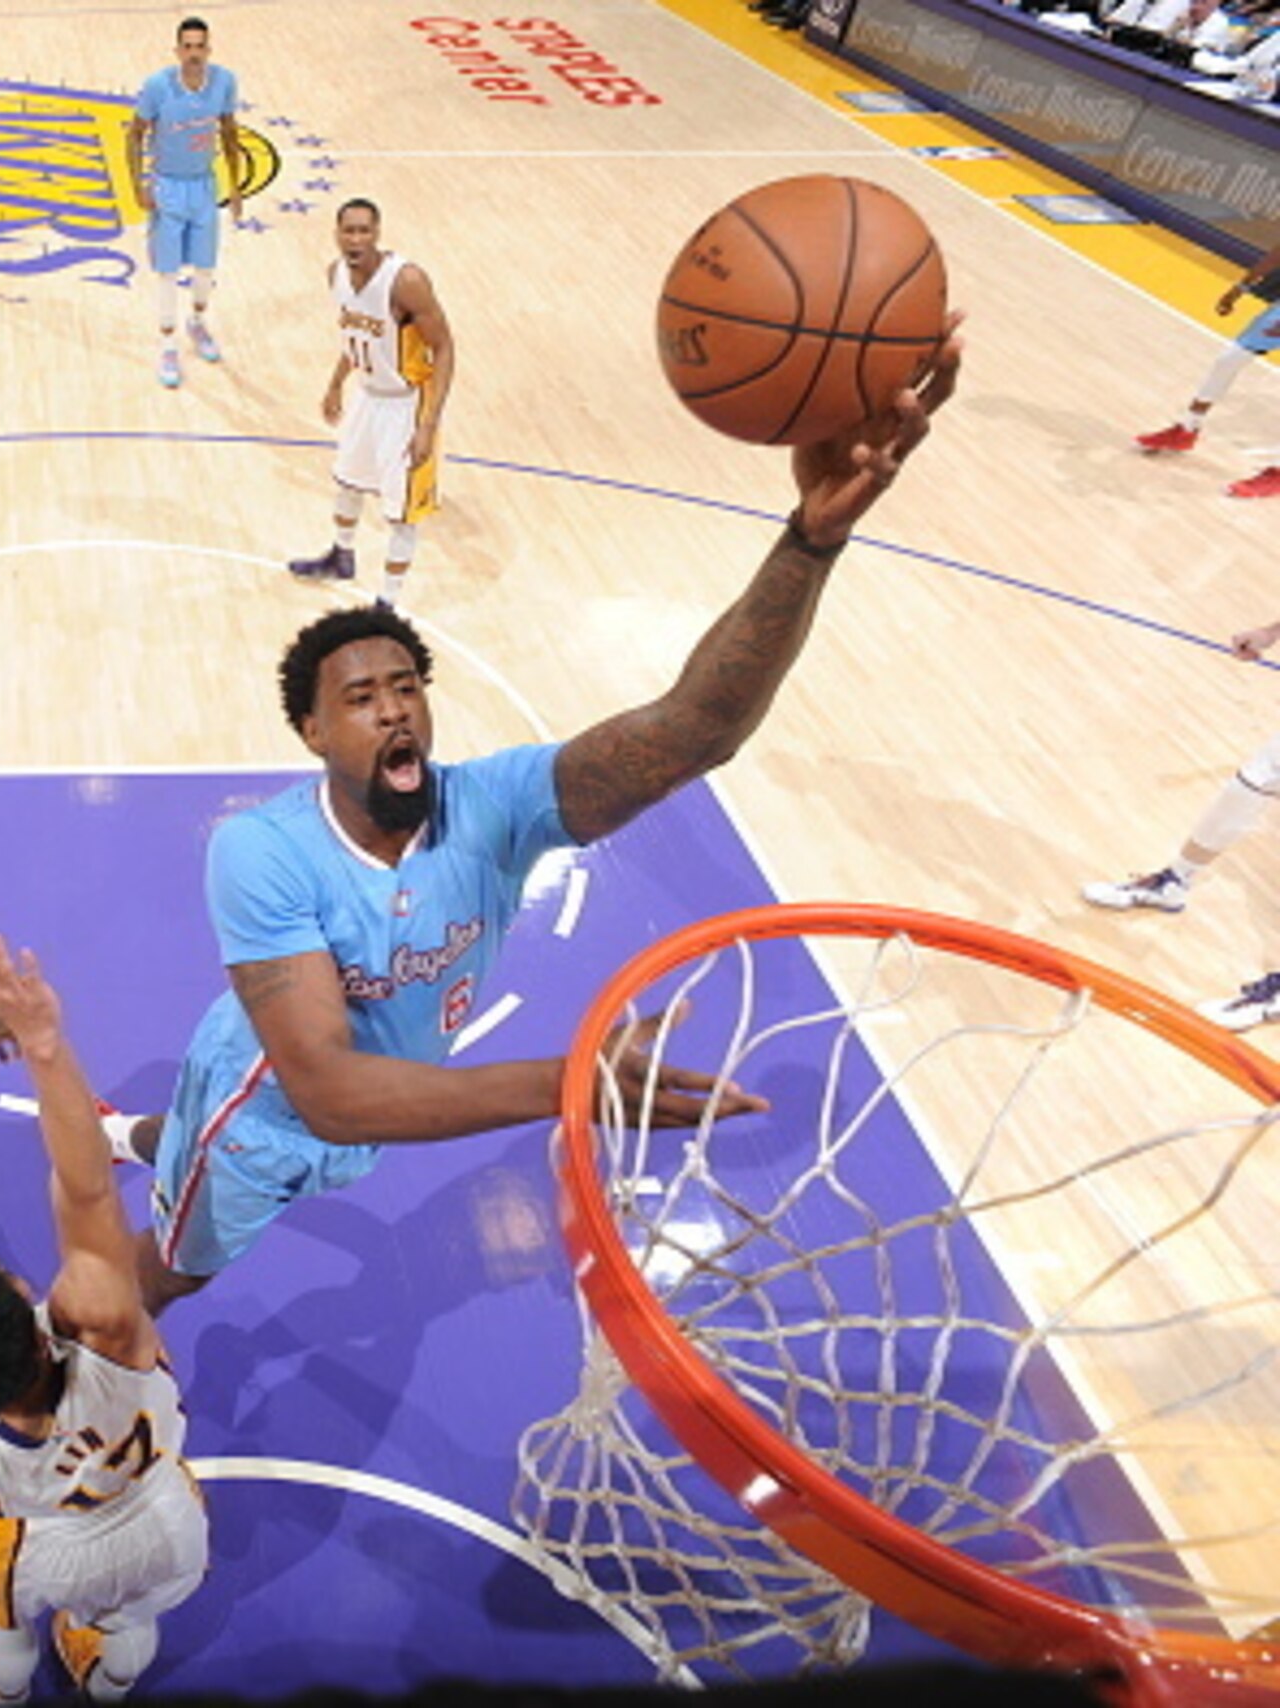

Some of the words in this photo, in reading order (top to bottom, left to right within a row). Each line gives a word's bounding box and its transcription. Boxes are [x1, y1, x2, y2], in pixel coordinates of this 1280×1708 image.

[409, 15, 554, 108] Center
[492, 16, 663, 108] STAPLES
[441, 971, 475, 1034] 6
